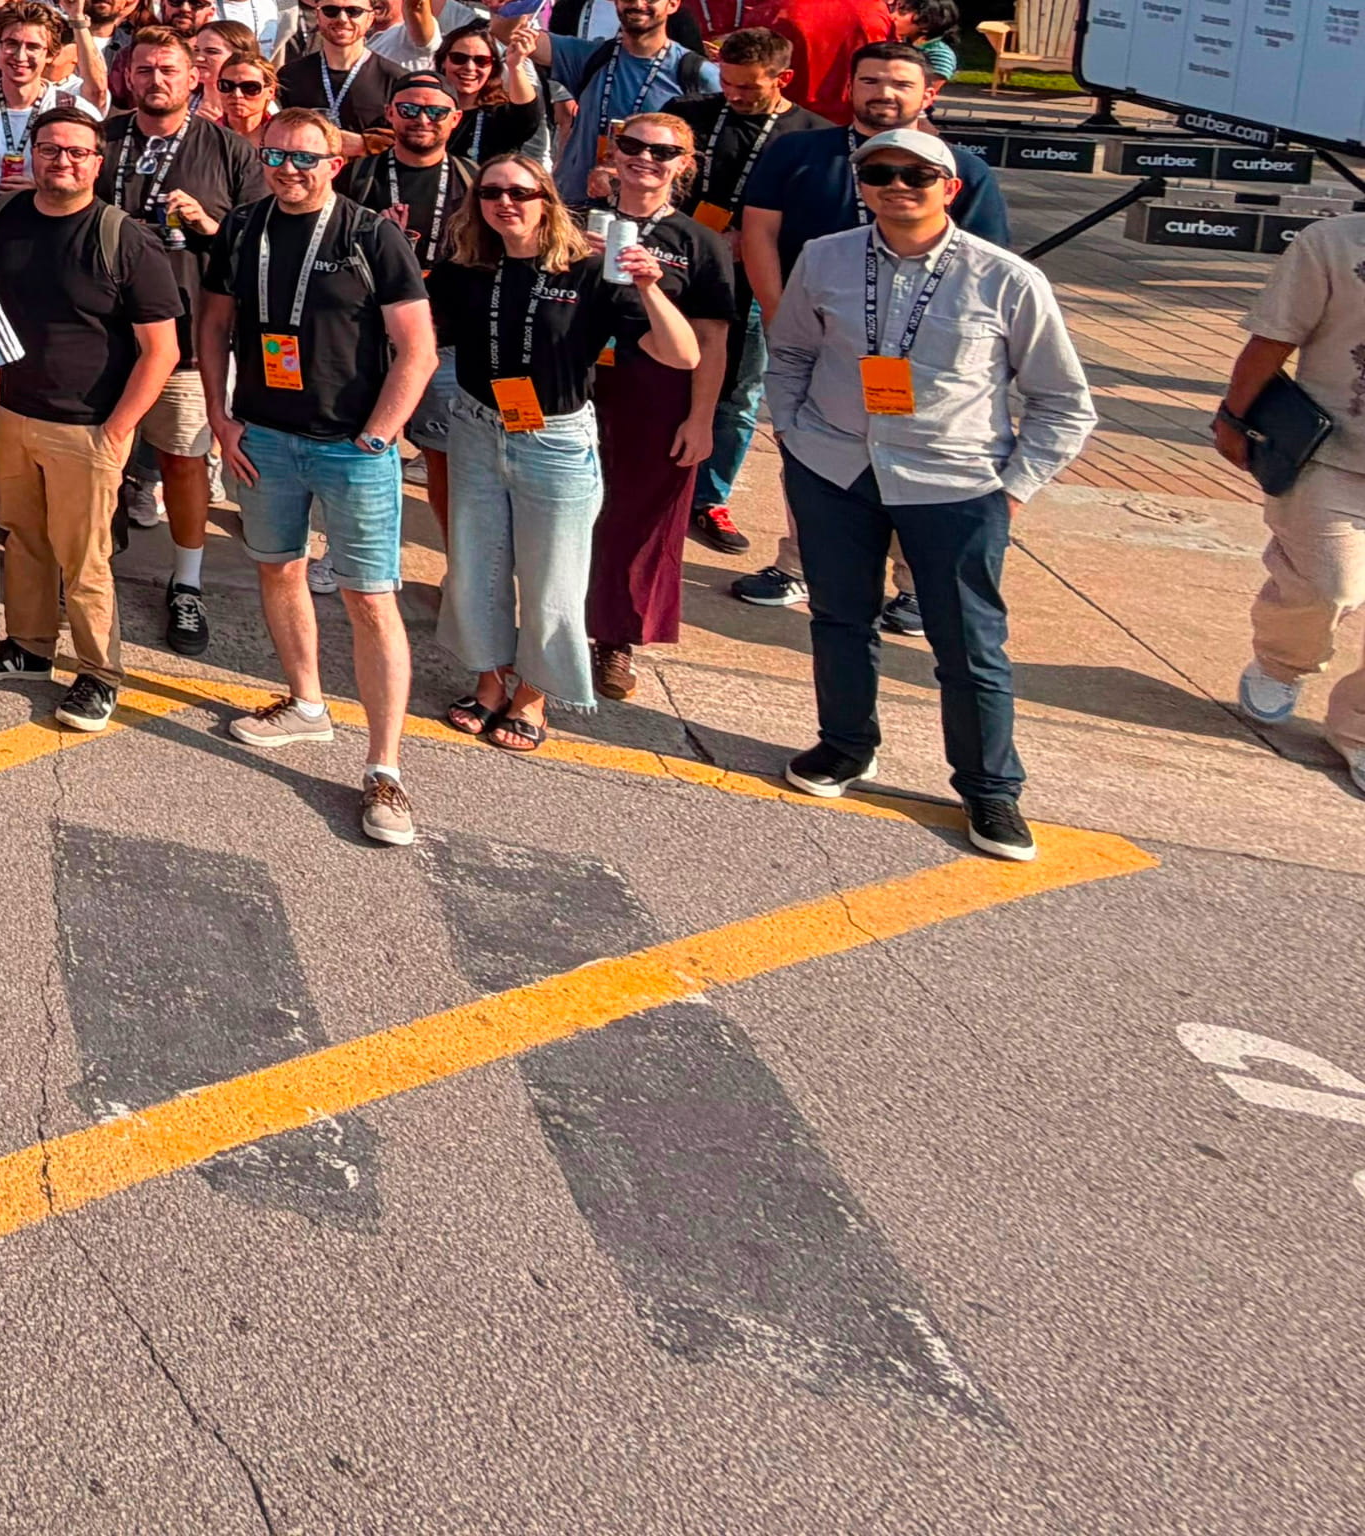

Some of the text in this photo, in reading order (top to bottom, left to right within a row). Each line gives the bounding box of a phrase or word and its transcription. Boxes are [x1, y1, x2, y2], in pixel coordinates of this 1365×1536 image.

[1183, 112, 1269, 145] curbex.com
[1020, 146, 1079, 162] curbex
[1136, 153, 1198, 169] curbex
[1231, 158, 1295, 174] curbex
[1164, 219, 1241, 239] curbex
